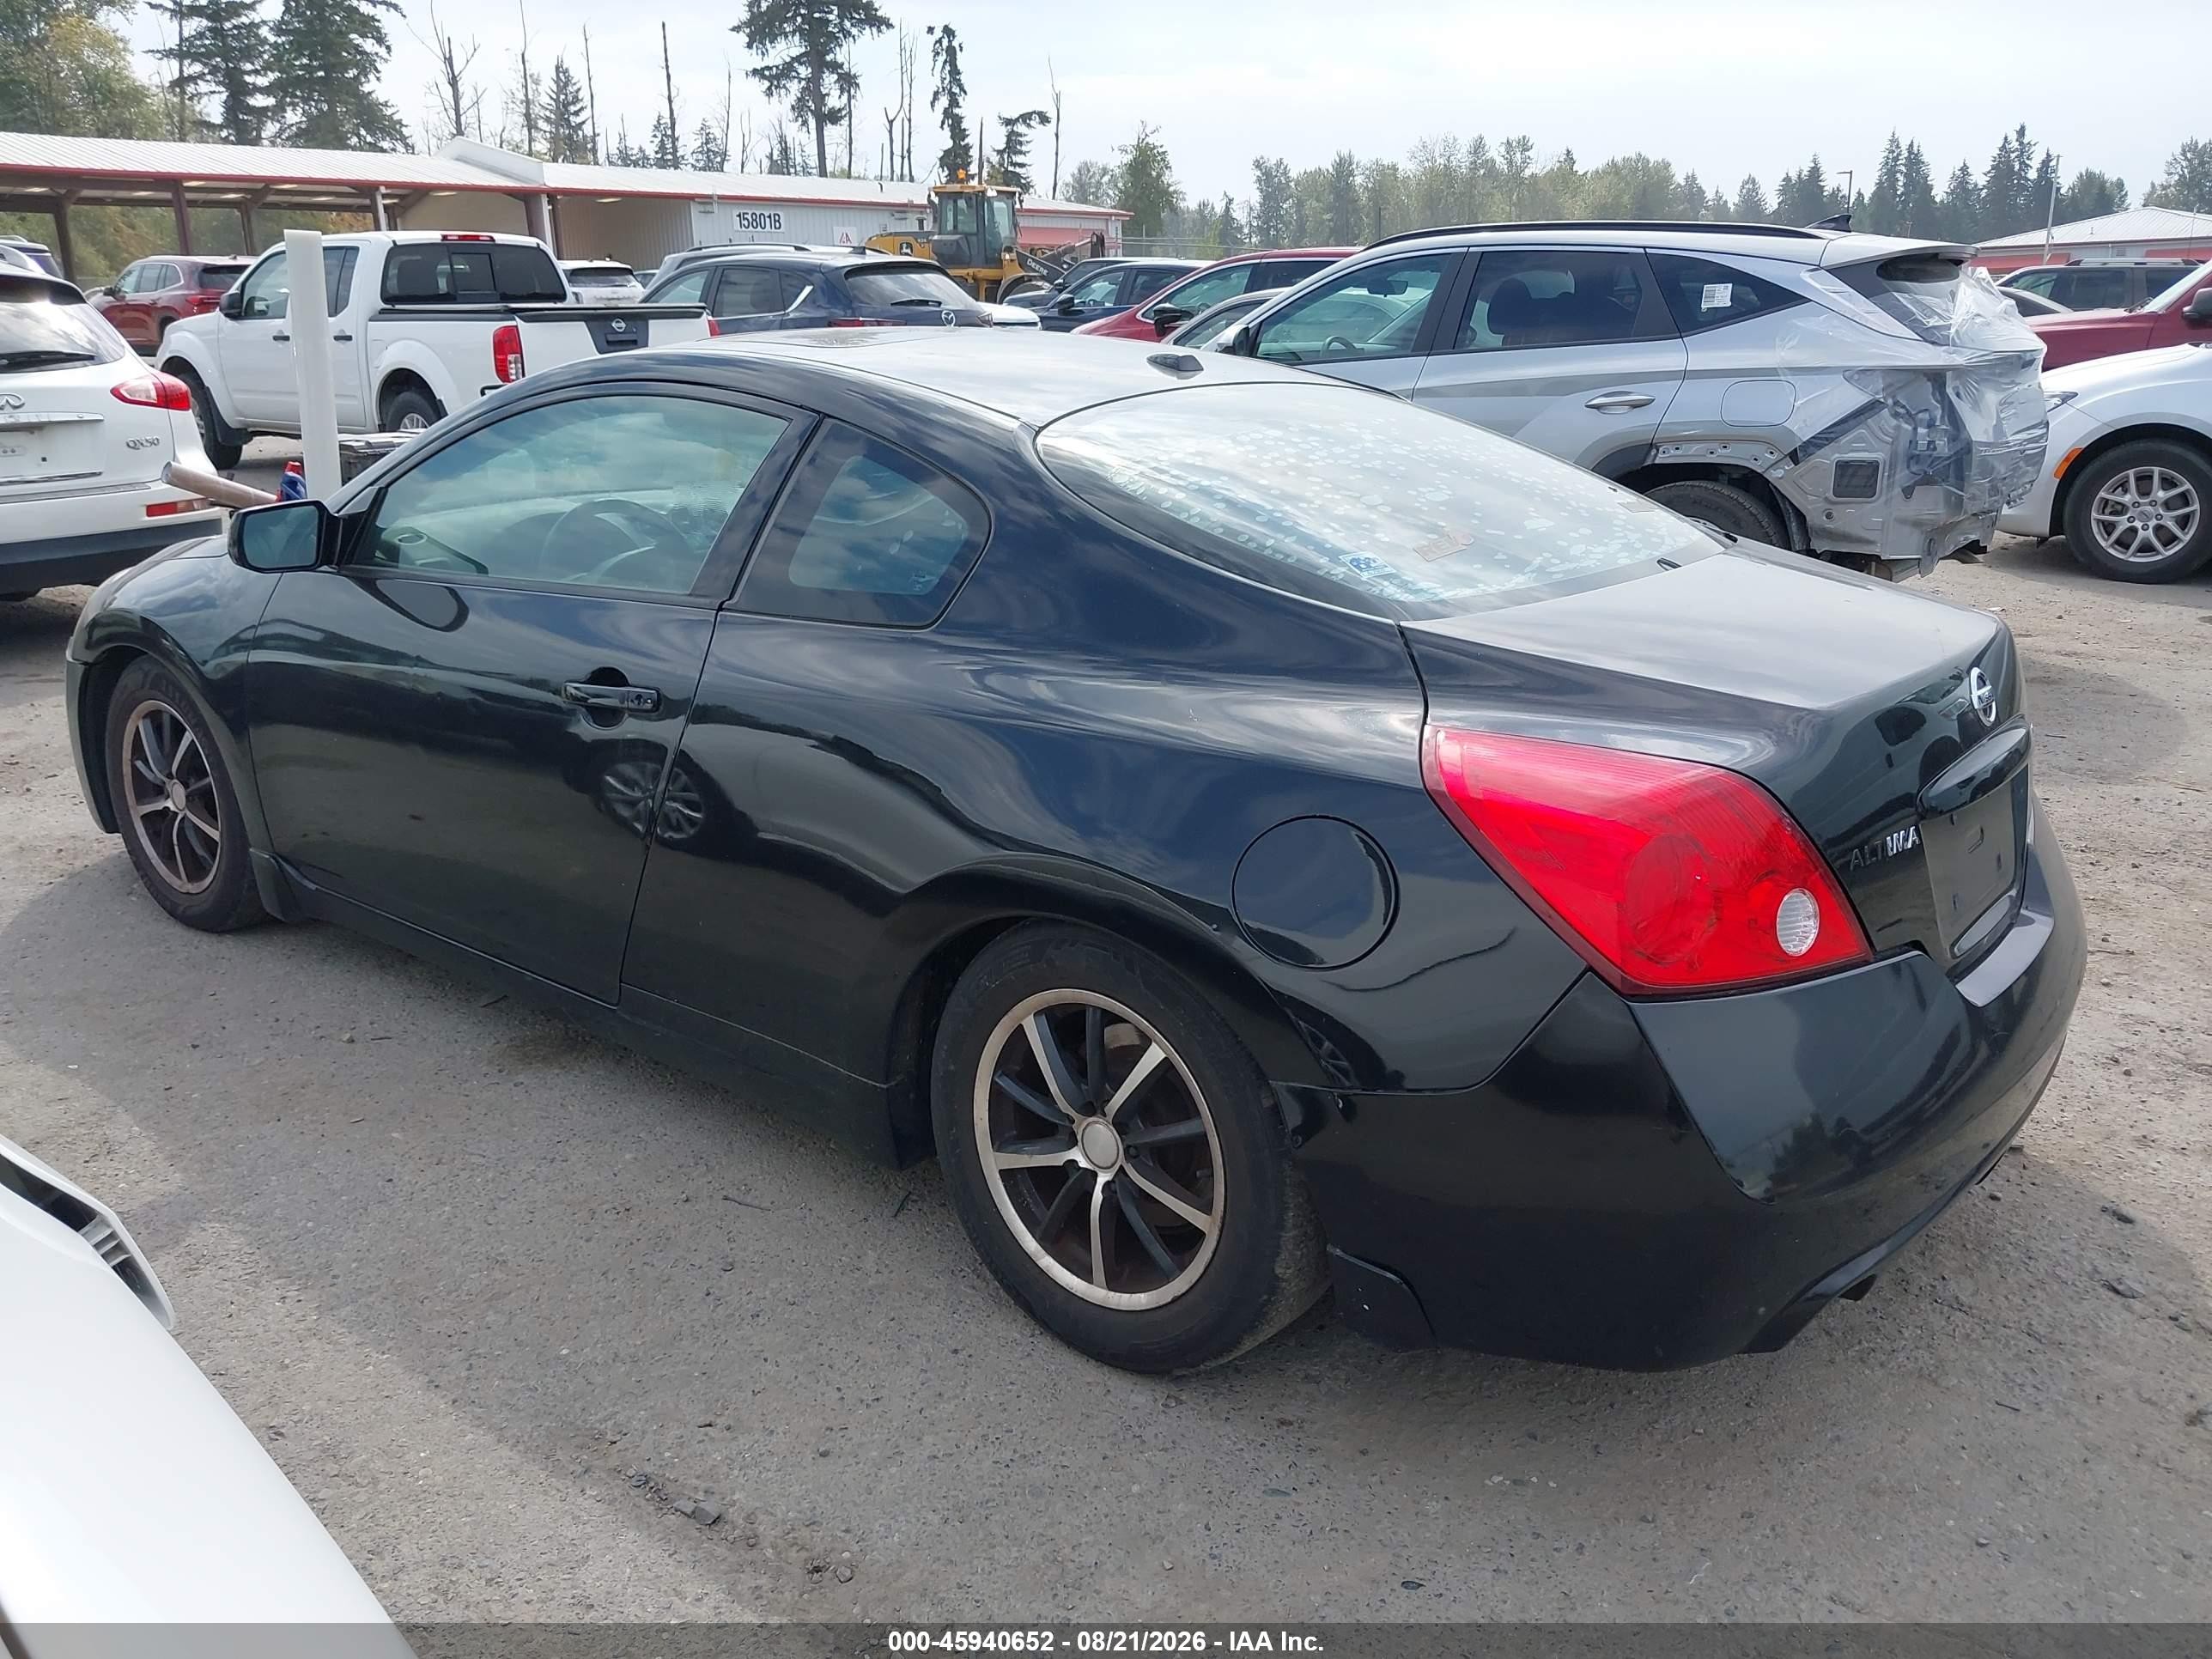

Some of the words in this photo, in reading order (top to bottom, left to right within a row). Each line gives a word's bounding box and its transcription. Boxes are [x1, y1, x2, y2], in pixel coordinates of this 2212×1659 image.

[736, 212, 782, 230] 15801B
[1028, 258, 1048, 276] DEERE
[126, 436, 160, 450] QX50
[1850, 826, 1920, 871] ALTIMA
